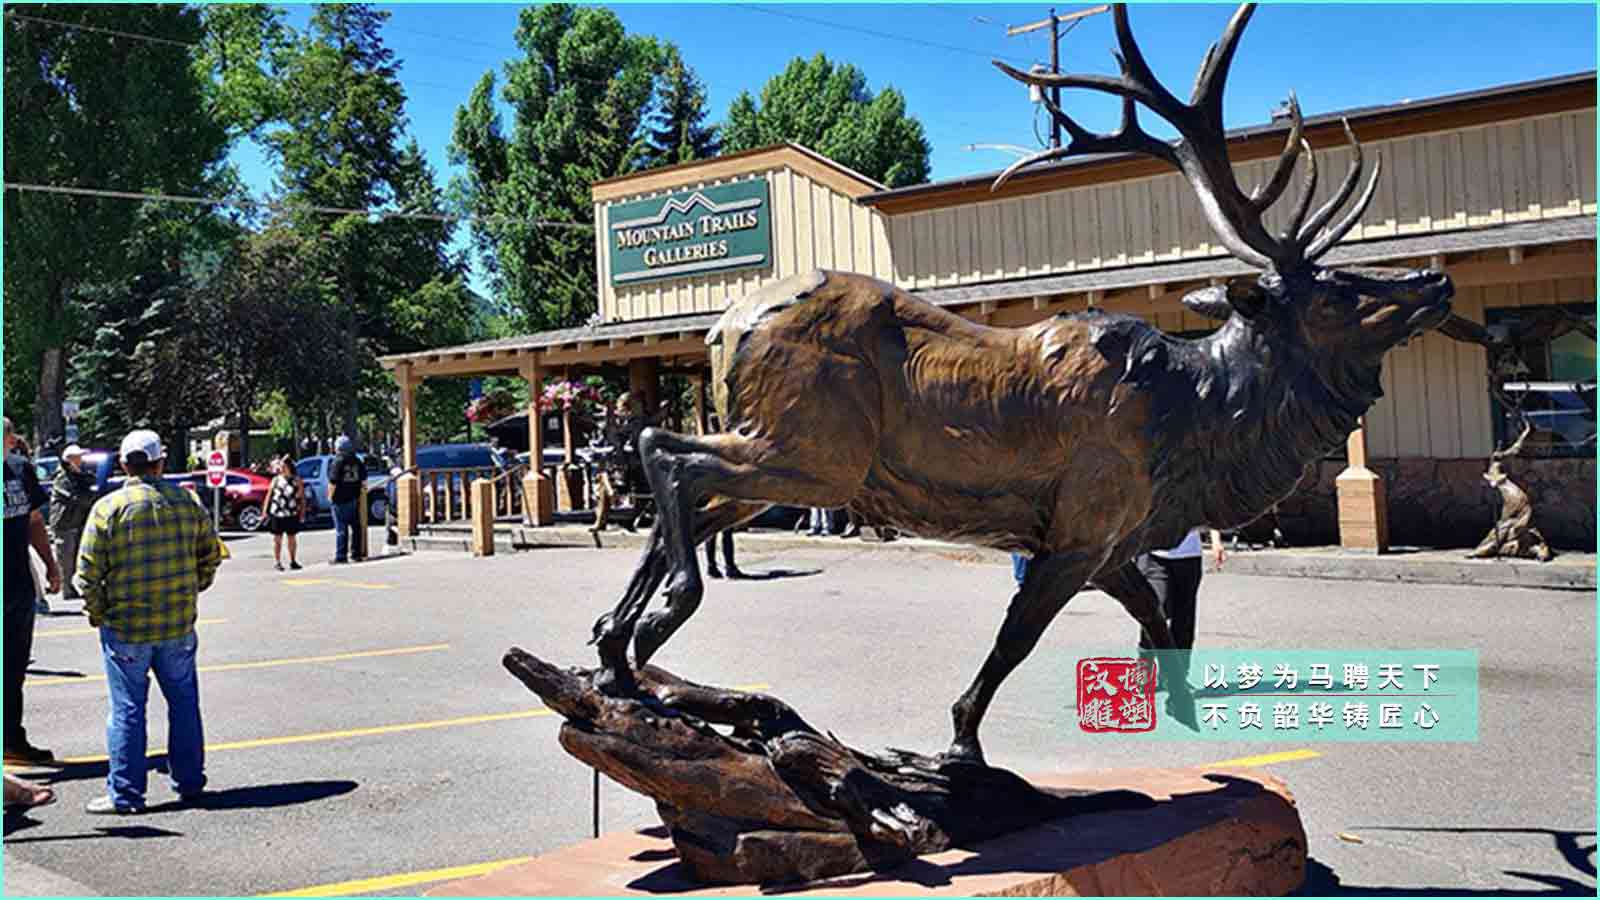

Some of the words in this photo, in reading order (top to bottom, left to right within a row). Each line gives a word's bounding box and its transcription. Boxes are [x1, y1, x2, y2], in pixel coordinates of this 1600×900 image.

[617, 222, 694, 248] MOUNTAIN
[699, 210, 758, 234] TRAILS
[643, 240, 728, 266] GALLERIES
